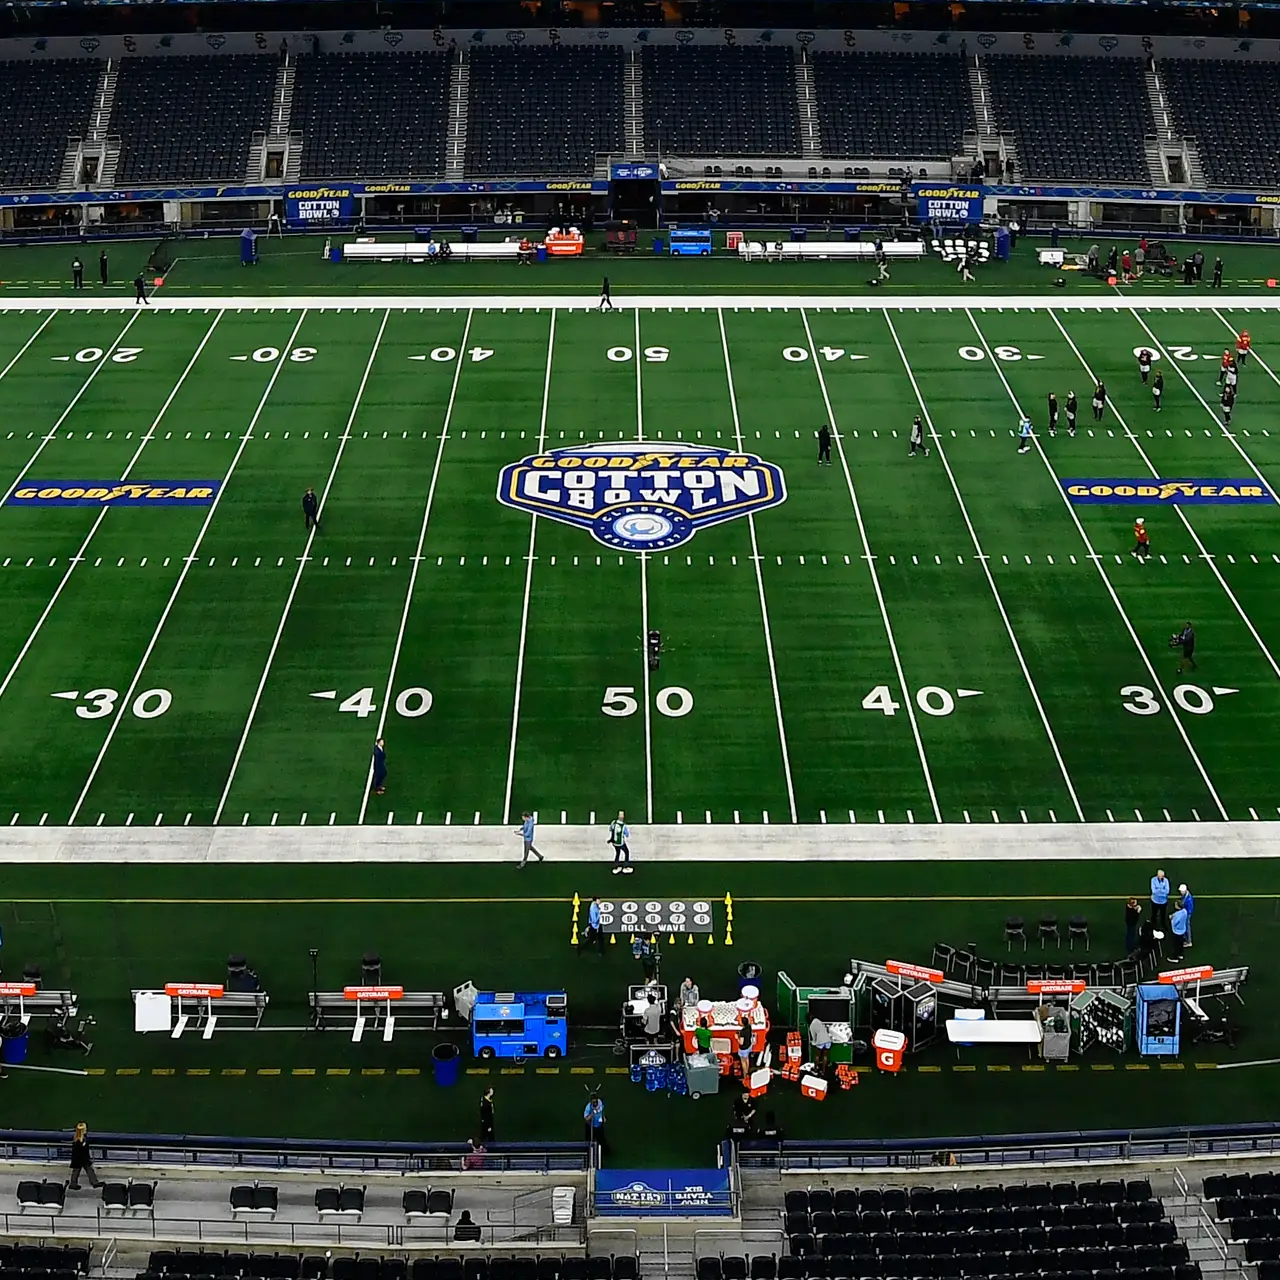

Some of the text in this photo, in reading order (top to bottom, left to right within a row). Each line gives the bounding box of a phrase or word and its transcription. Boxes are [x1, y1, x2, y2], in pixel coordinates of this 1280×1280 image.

[365, 183, 411, 192] GOODYEAR
[546, 181, 592, 190] GOODYEAR
[675, 181, 721, 190] GOODYEAR
[288, 187, 350, 200] GOODYEAR
[918, 187, 980, 199] GOODYEAR
[298, 201, 340, 210] COTTON
[928, 200, 970, 209] COTTON
[299, 210, 331, 219] BOWL
[928, 209, 960, 218] BOWL
[532, 454, 753, 469] GOODYEAR
[14, 485, 213, 500] GOODYEAR
[523, 470, 761, 502] COTTON
[1067, 483, 1268, 499] GOODYEAR
[567, 489, 718, 509] BOWL
[602, 506, 684, 523] CLASSIC
[604, 533, 636, 548] EST.
[73, 687, 173, 719] 30
[337, 687, 434, 718] 40
[601, 685, 694, 718] 50
[861, 685, 956, 718] 40
[1120, 684, 1216, 717] 30
[658, 924, 686, 932] WAVE
[898, 967, 930, 979] GATORADE
[1172, 972, 1201, 982] GATORADE
[881, 1052, 894, 1066] G
